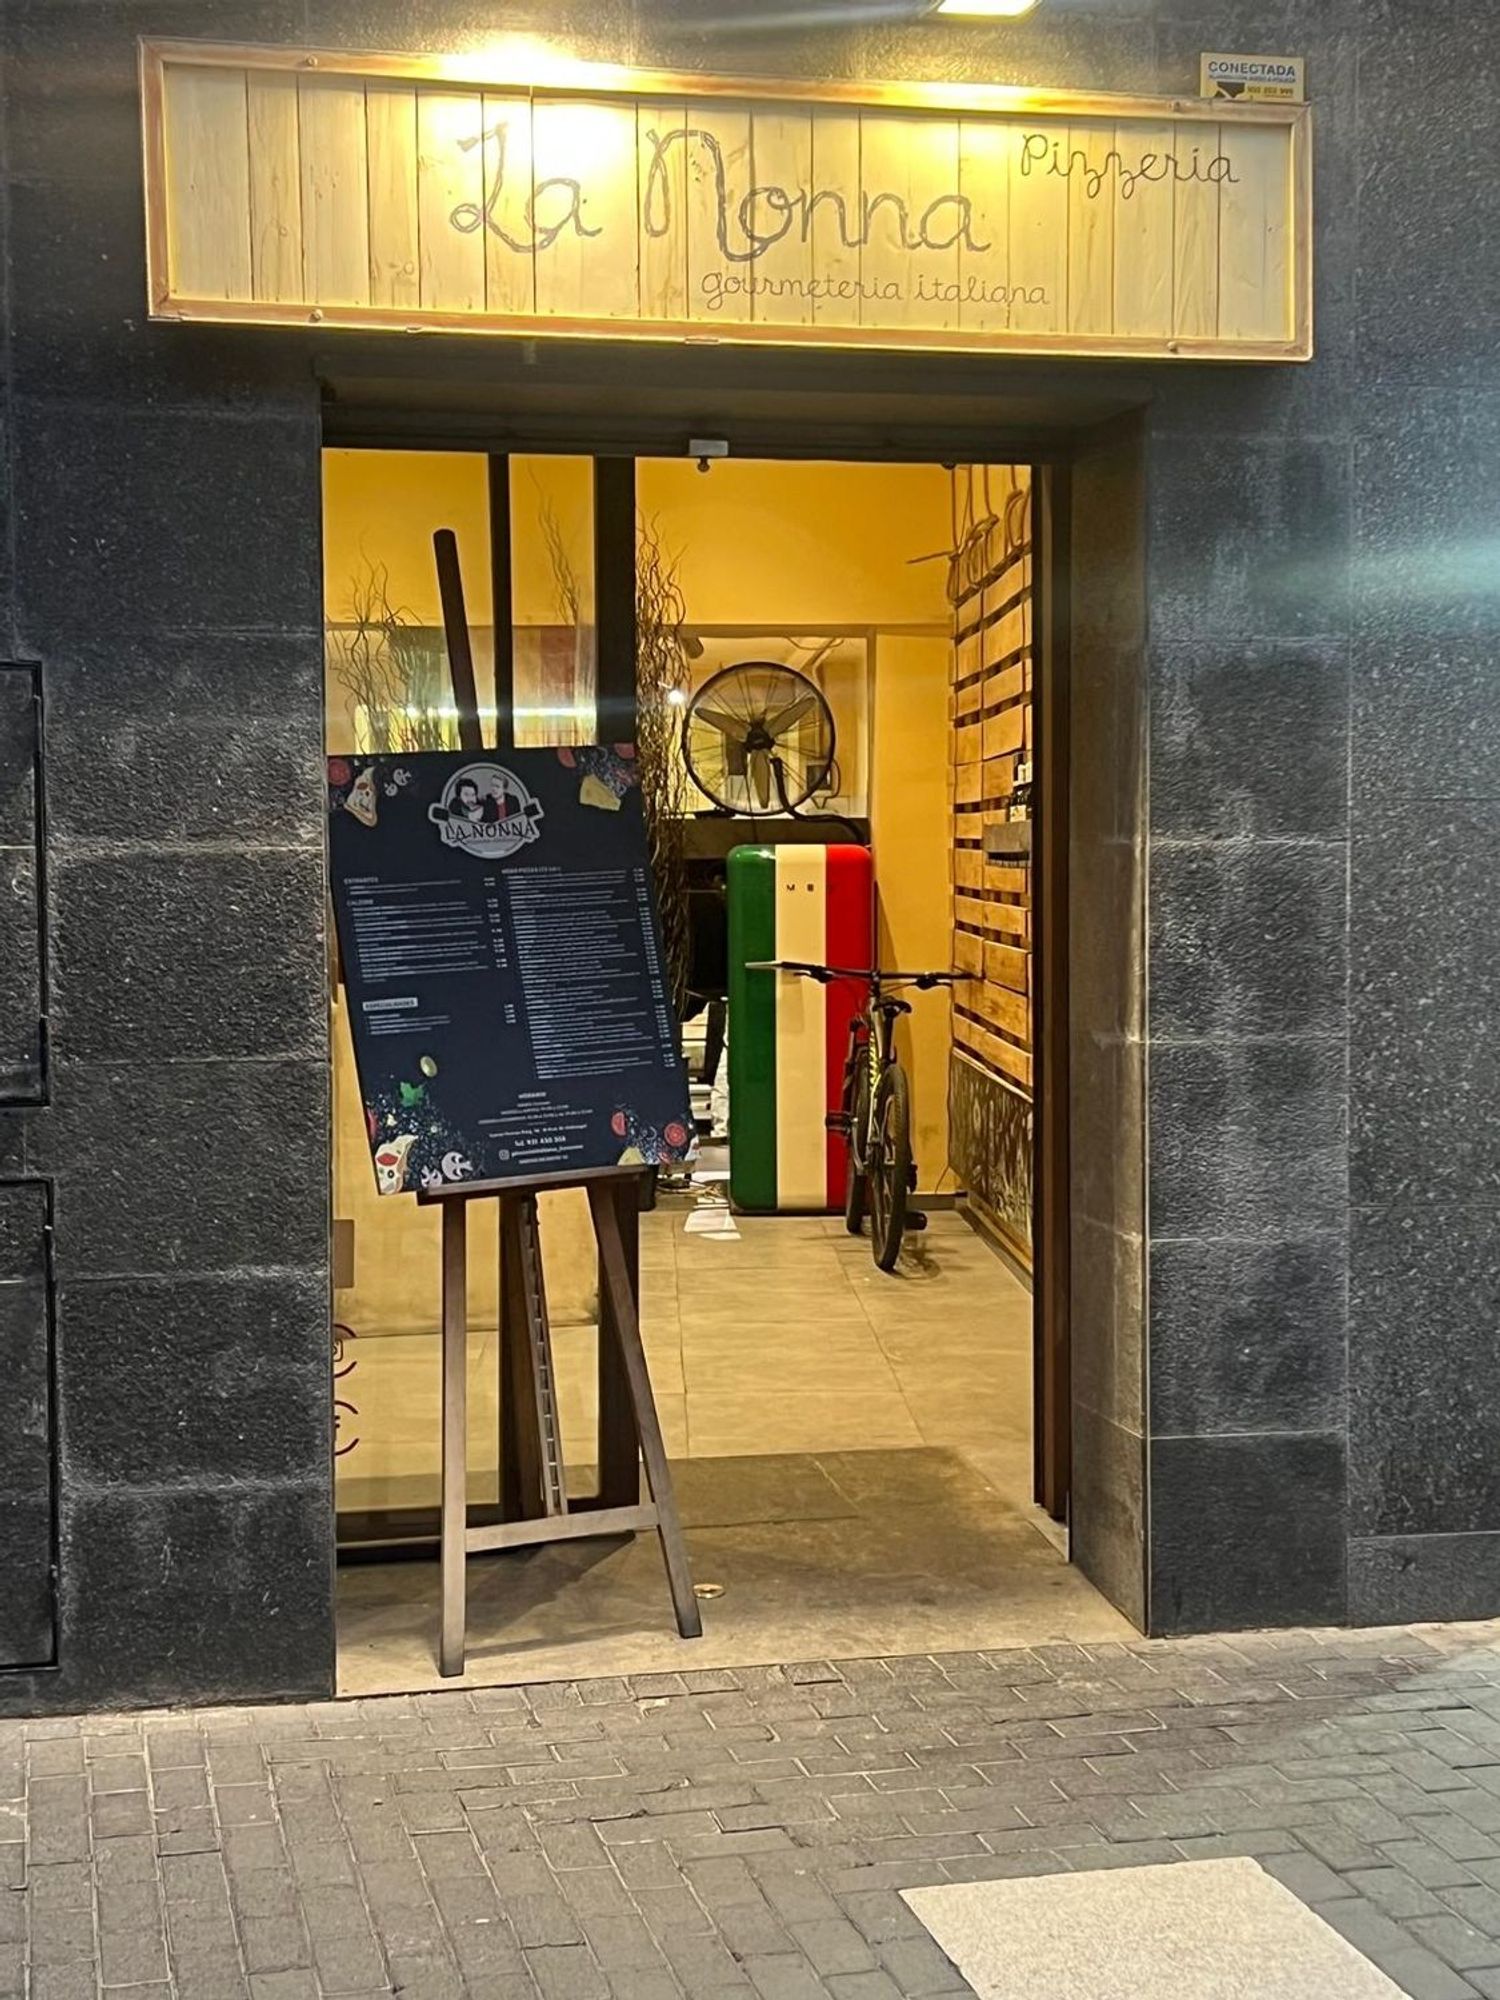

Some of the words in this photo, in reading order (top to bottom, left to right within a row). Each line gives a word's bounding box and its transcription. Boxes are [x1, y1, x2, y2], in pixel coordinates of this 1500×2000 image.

[1208, 61, 1295, 76] CONECTADA
[1020, 133, 1240, 200] Pizzeria
[449, 121, 603, 253] La
[643, 128, 991, 262] Nonna
[701, 271, 903, 311] gourmeteria
[914, 273, 1050, 306] italiana
[445, 822, 470, 845] LA
[472, 819, 537, 840] NONNA
